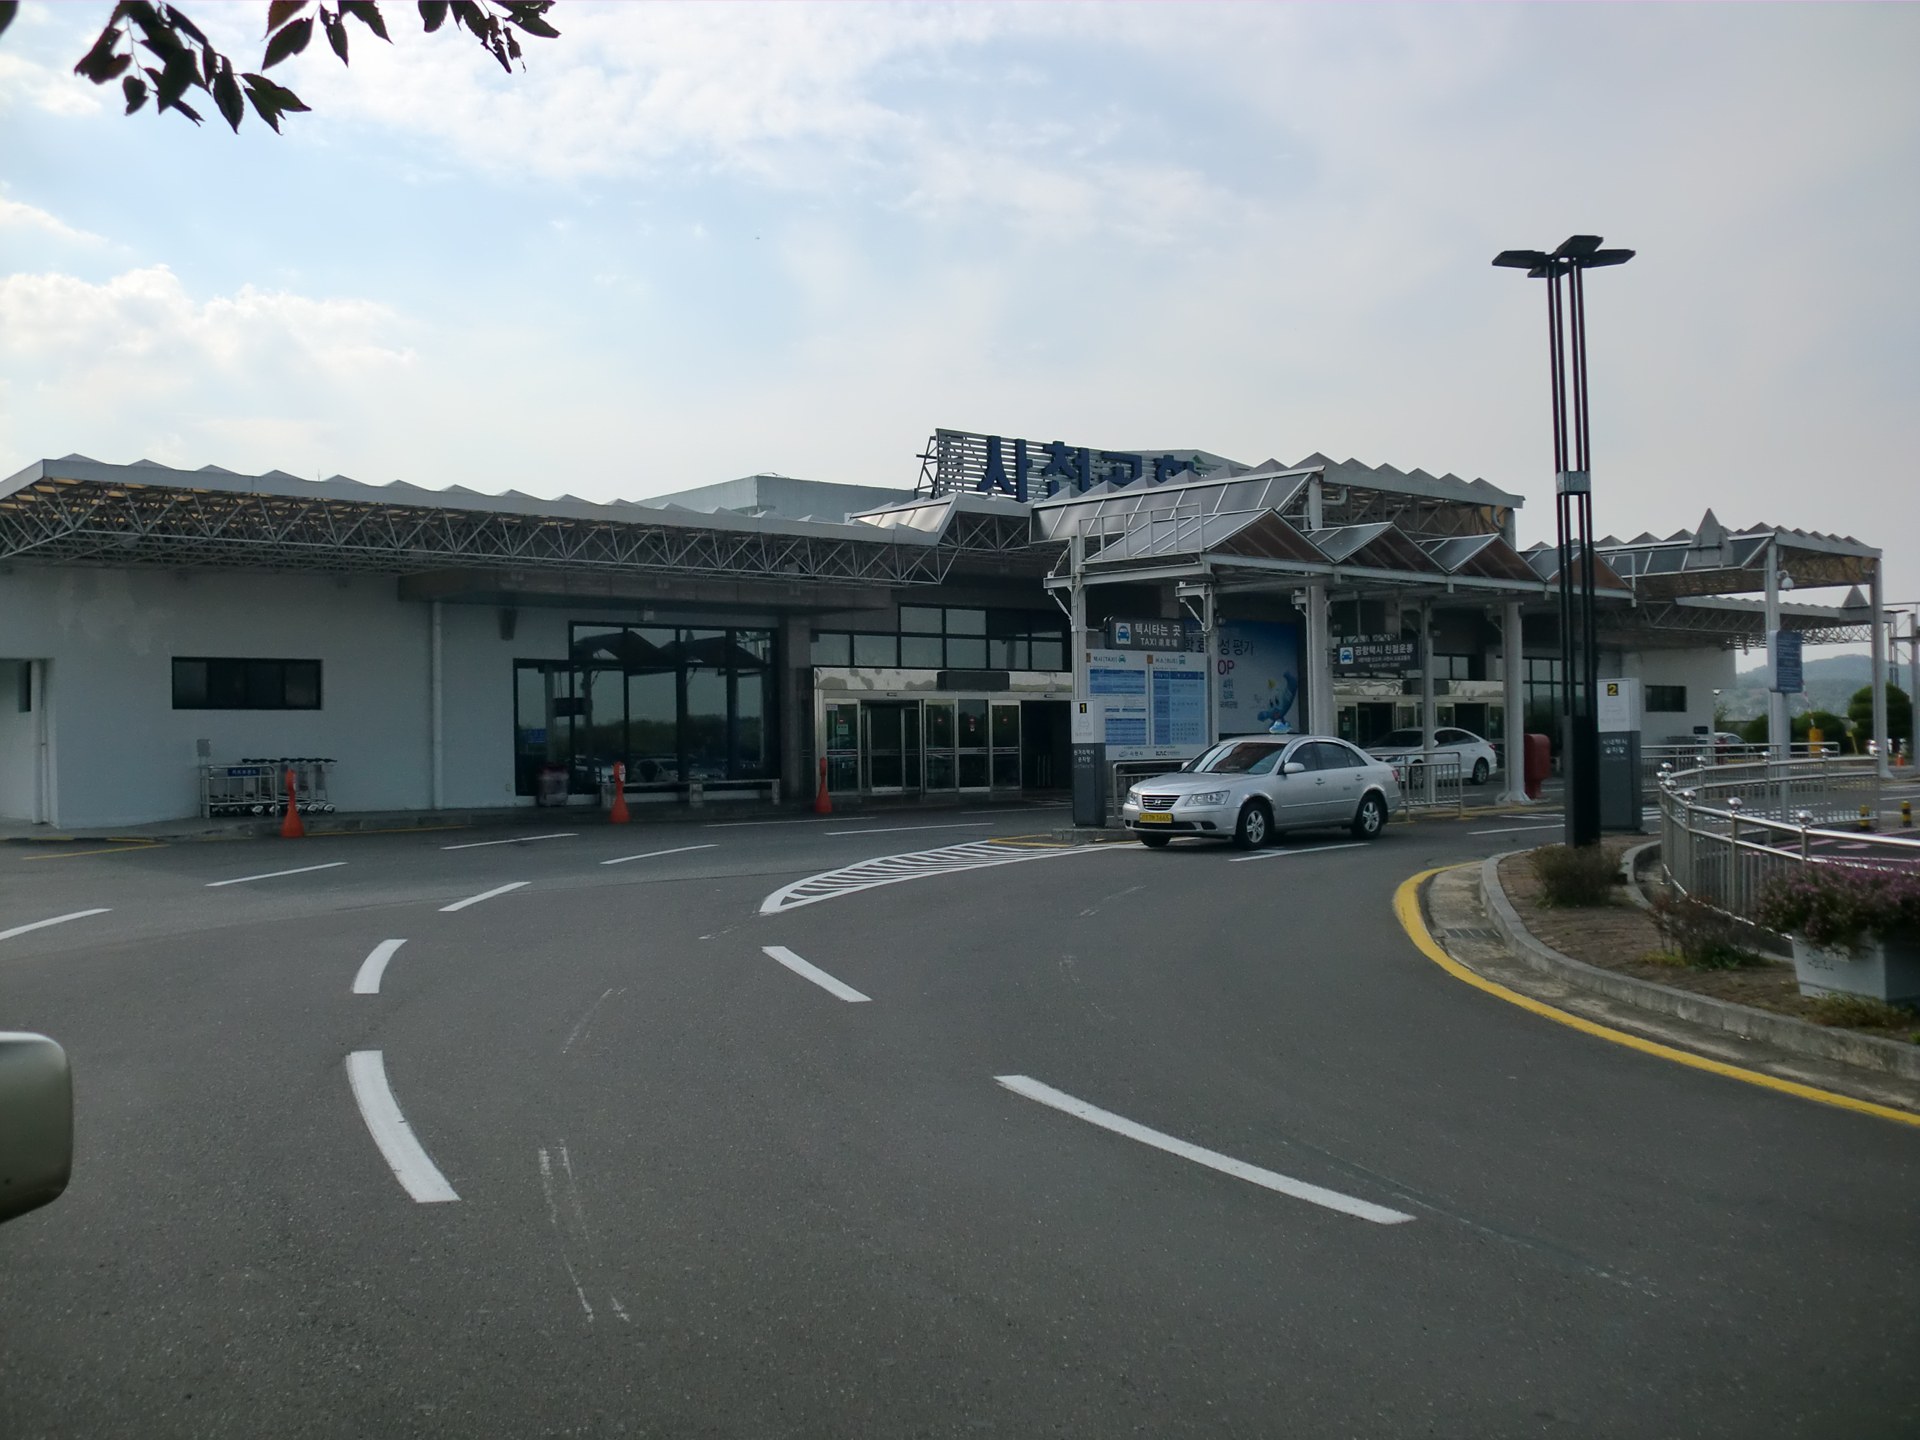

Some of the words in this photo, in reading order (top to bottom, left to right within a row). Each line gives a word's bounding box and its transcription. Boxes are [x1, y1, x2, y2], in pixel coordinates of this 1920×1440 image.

[1135, 623, 1168, 636] 택시타는
[1172, 624, 1181, 637] 곳
[1140, 638, 1157, 646] TAXI
[1233, 639, 1254, 656] 평가
[1608, 685, 1617, 695] 2
